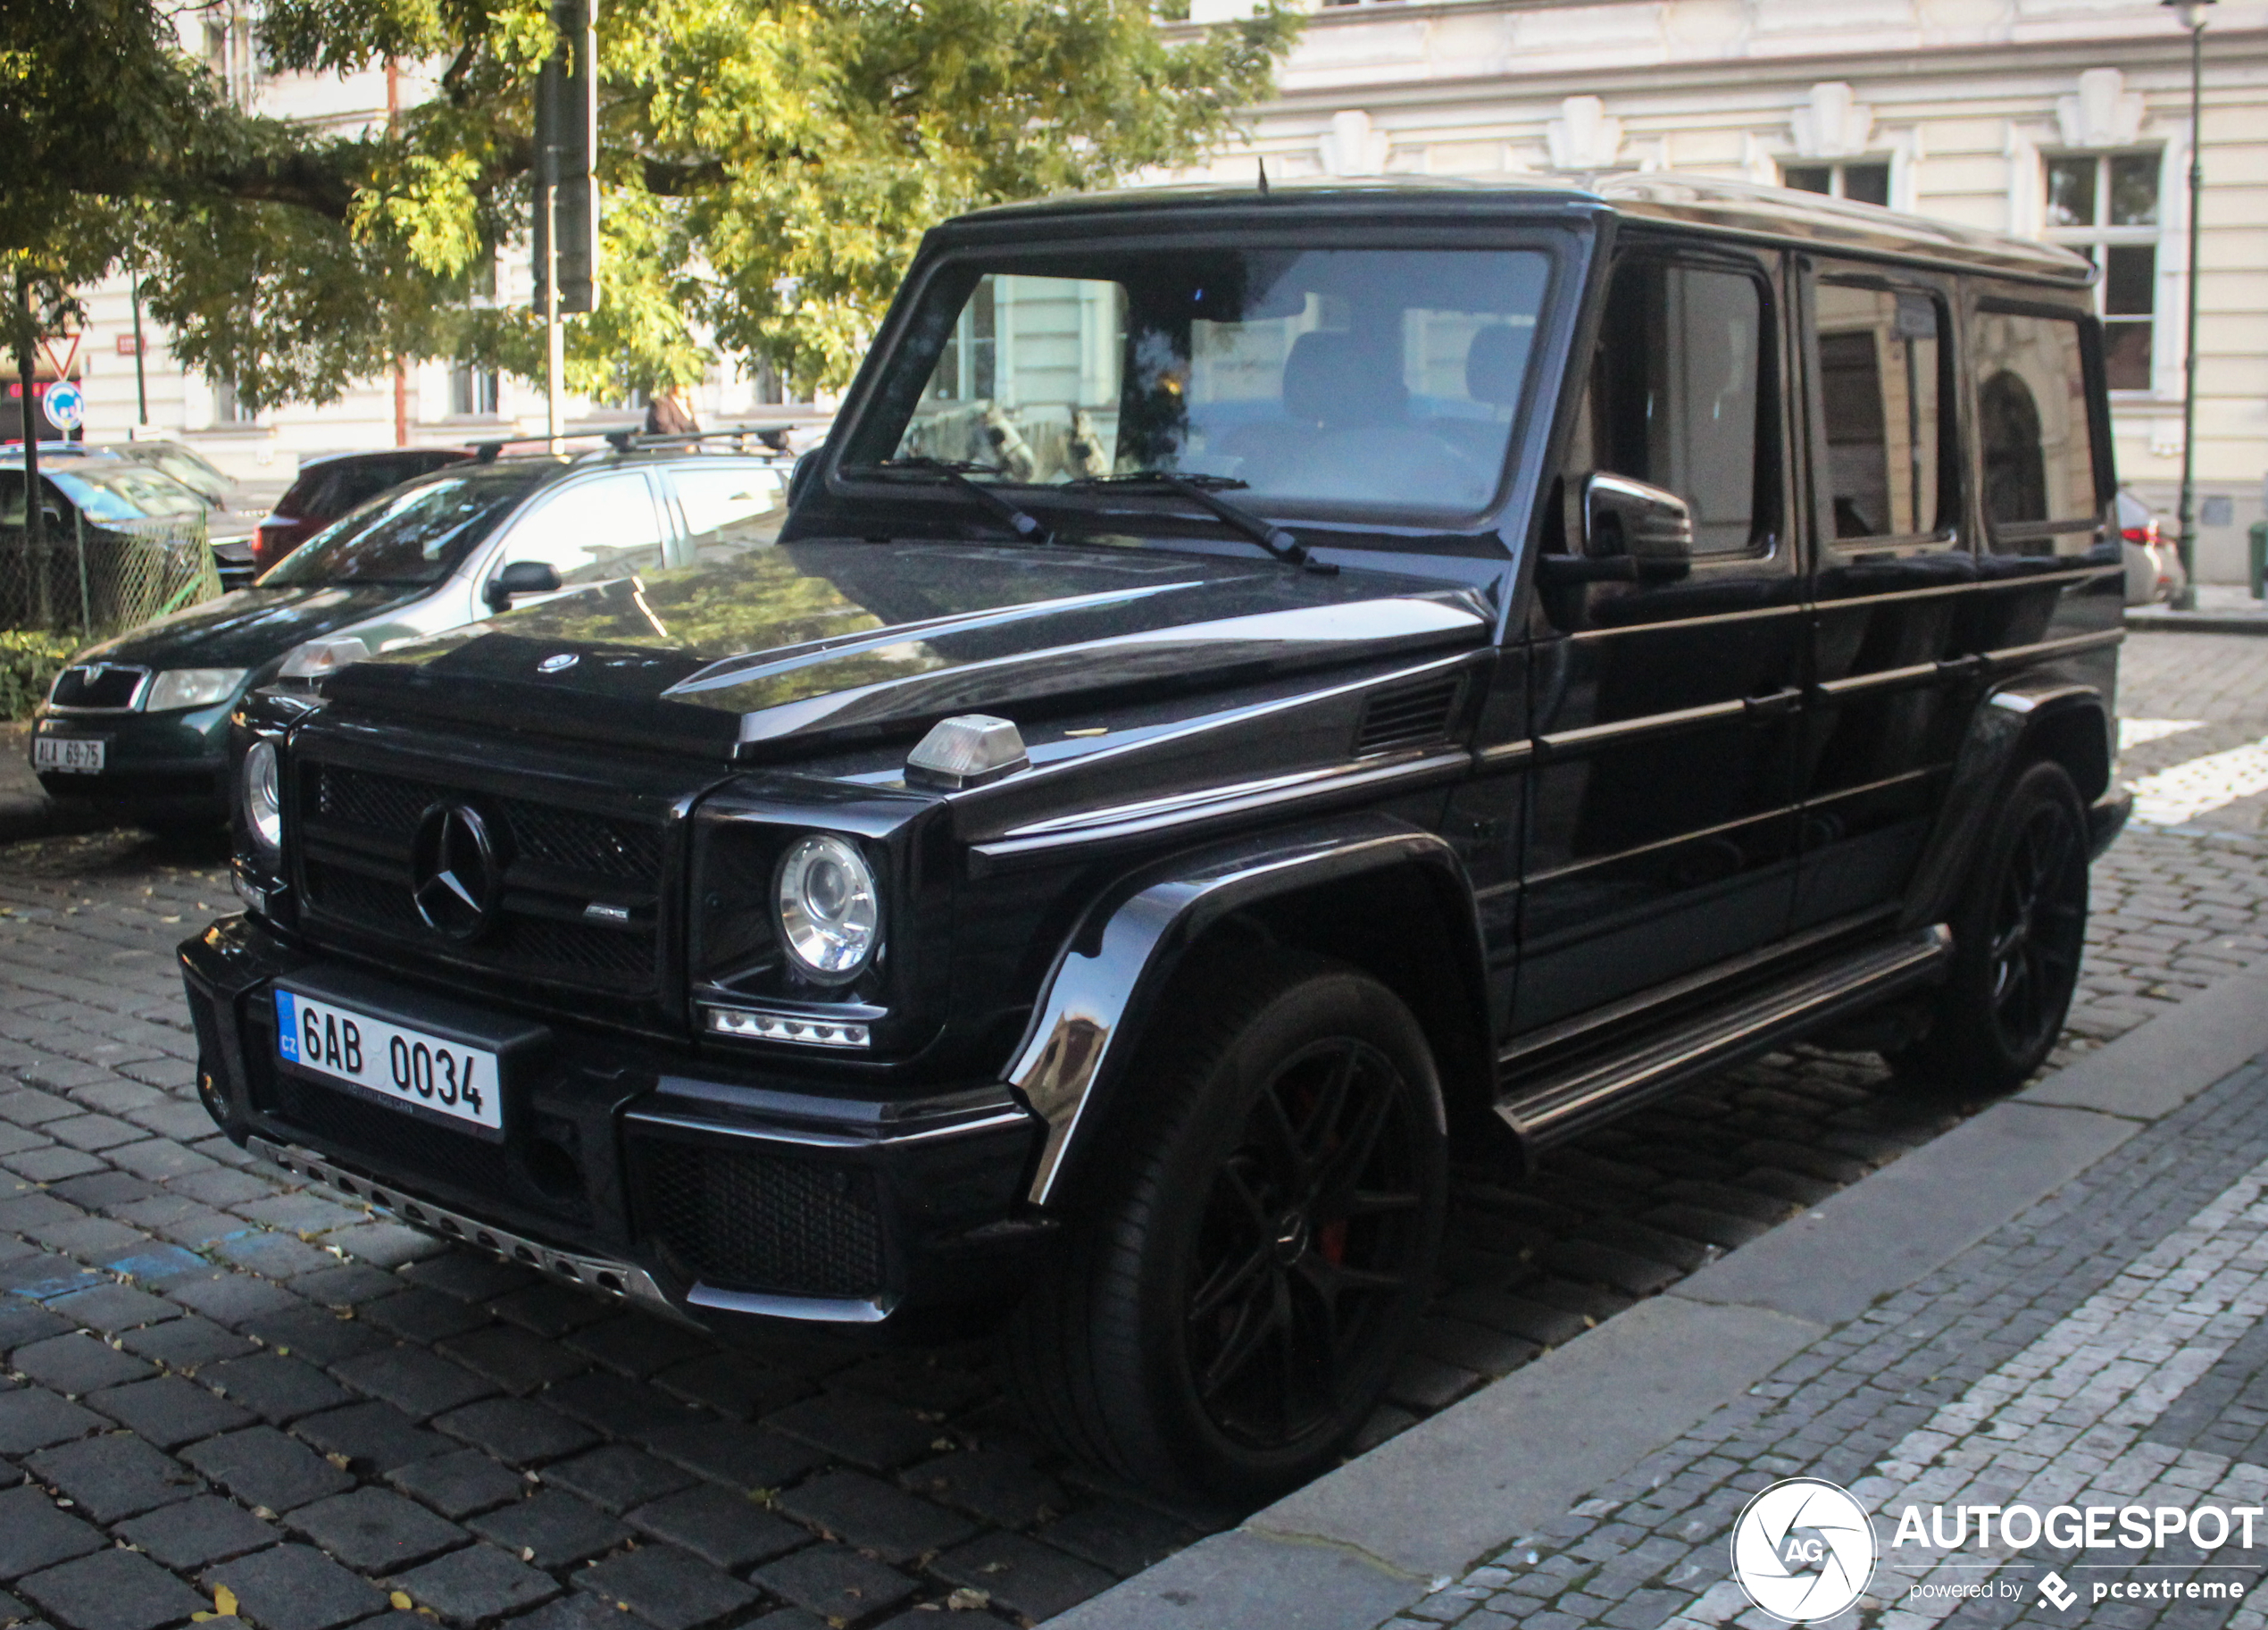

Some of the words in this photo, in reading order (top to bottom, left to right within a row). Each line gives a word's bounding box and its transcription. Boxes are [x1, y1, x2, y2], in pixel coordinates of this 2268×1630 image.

[66, 742, 99, 767] 69-75
[281, 1034, 297, 1055] CZ
[303, 1007, 363, 1074] 6AB
[389, 1034, 483, 1116] 0034
